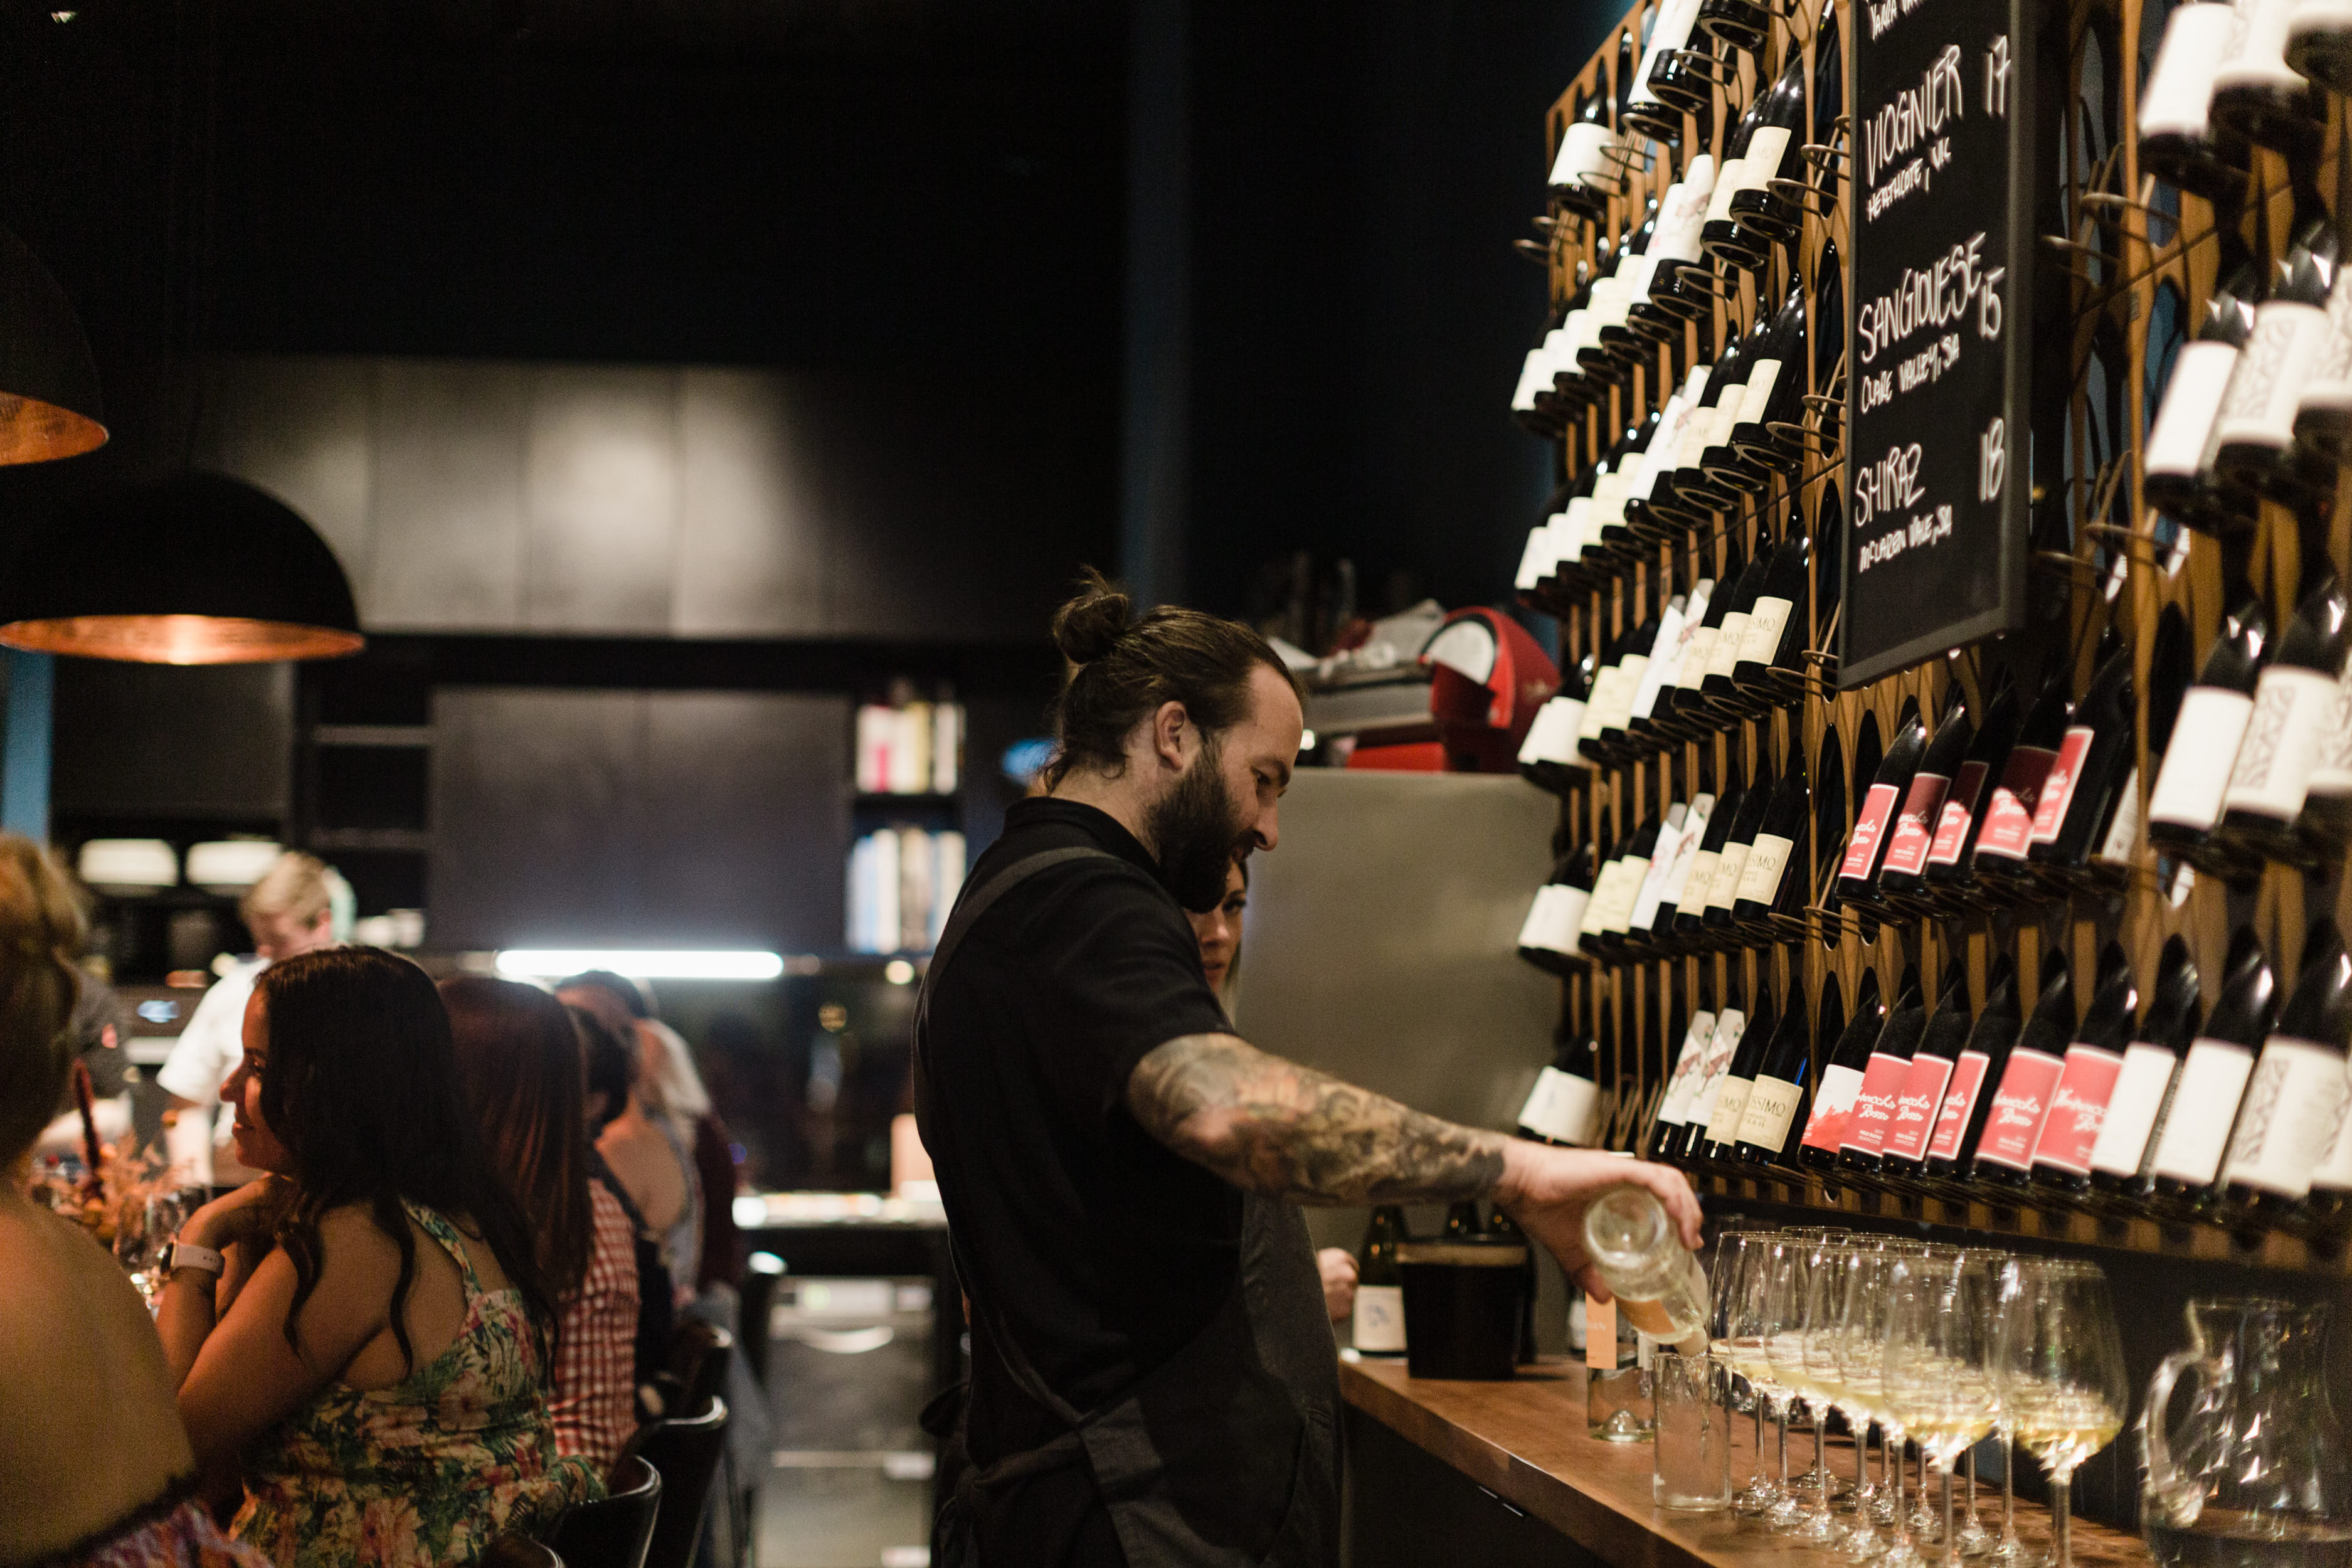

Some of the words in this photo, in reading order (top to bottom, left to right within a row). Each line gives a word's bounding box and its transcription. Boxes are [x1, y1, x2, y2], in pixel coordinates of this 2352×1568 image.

[1867, 44, 1963, 188] VIOGNIER
[1986, 35, 2011, 115] 17
[1932, 137, 1951, 171] VIC
[1858, 232, 1986, 363] SANGIOVESE
[1980, 267, 2005, 339] 15
[1855, 442, 1926, 527] SHIRAZ
[1980, 417, 2005, 501] 18
